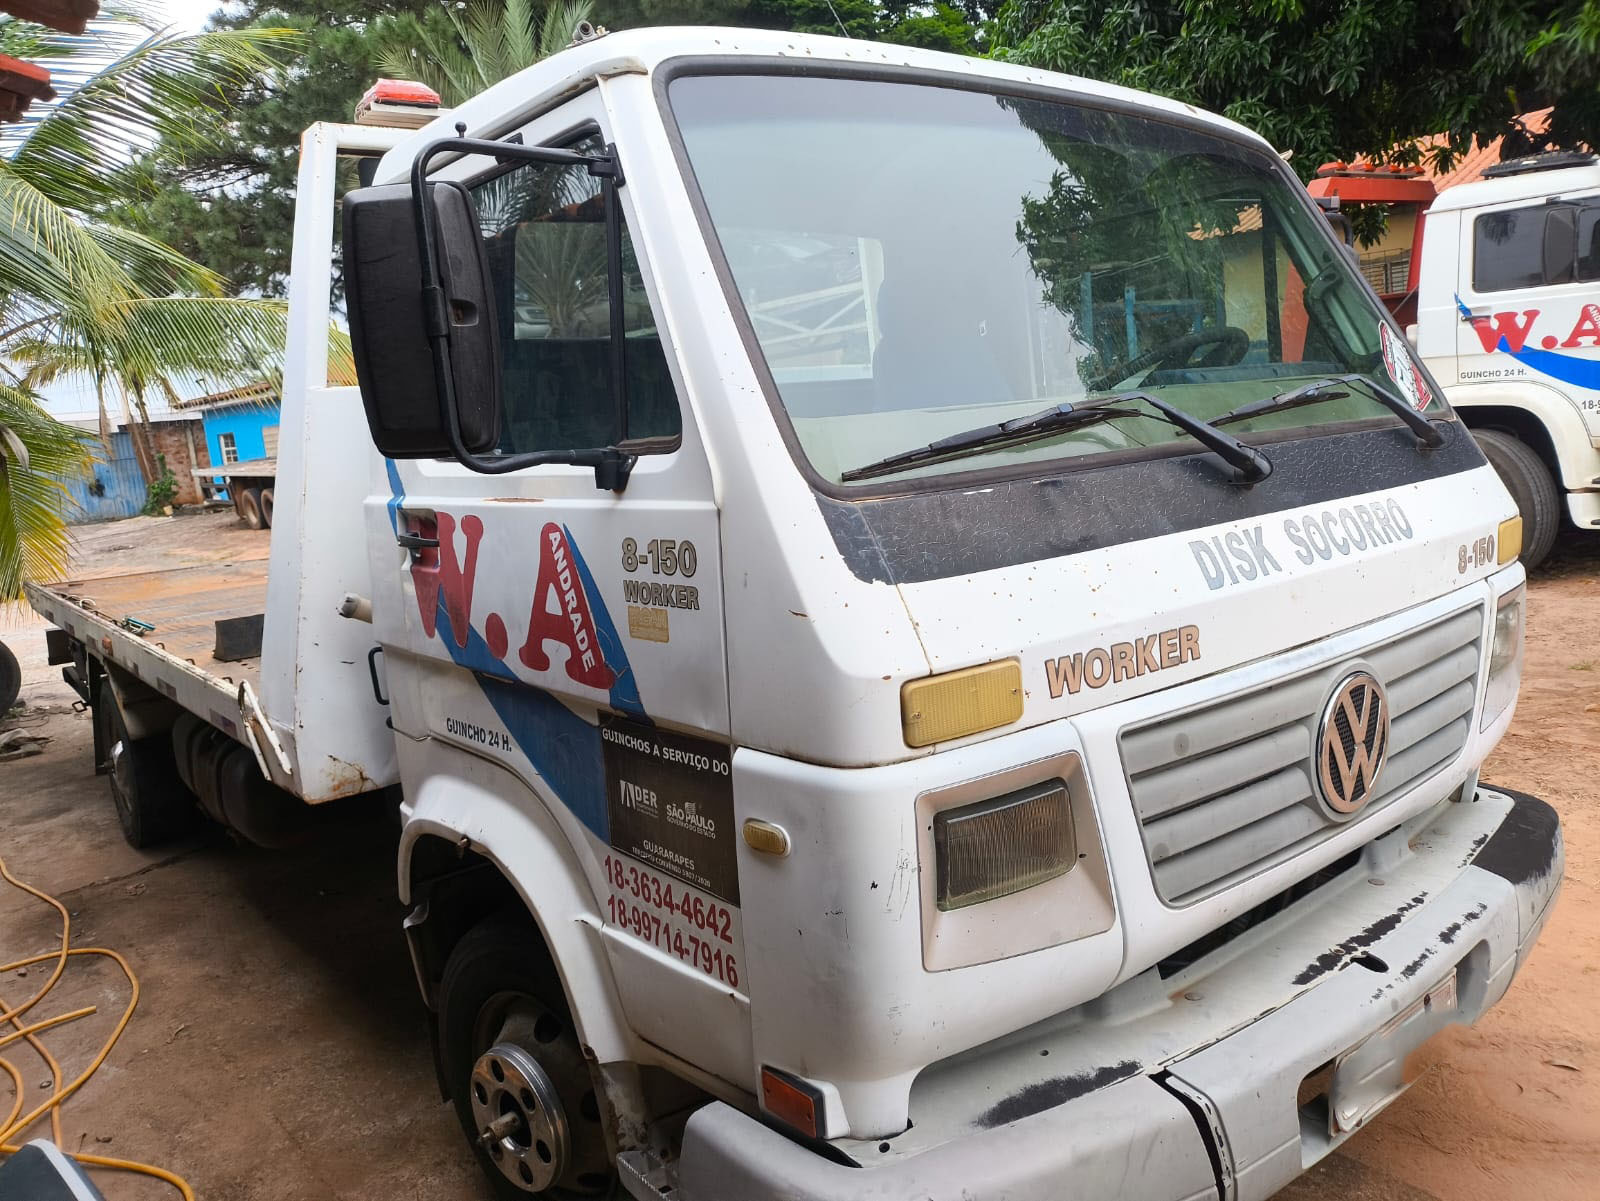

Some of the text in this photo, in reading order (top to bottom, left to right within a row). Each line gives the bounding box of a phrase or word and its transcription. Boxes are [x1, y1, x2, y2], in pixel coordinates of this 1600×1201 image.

[1460, 368, 1527, 379] GUINCHO 24 H.
[622, 537, 698, 578] 8-150
[1188, 497, 1414, 591] DISK SOCORRO
[1458, 534, 1495, 575] 8-150
[549, 531, 596, 674] ANDRADE
[623, 579, 700, 610] WORKER
[1044, 624, 1201, 700] WORKER
[446, 717, 512, 752] GUINCHO 24 H.
[602, 727, 730, 776] GUINCHOS A SERVIÇO DO
[635, 785, 658, 809] DER
[666, 803, 685, 820] SÃO
[685, 813, 716, 832] PAULO
[643, 840, 695, 870] GUARARAPES
[604, 854, 734, 945] 18-3634-4642
[607, 894, 739, 988] 18-99714-7916
